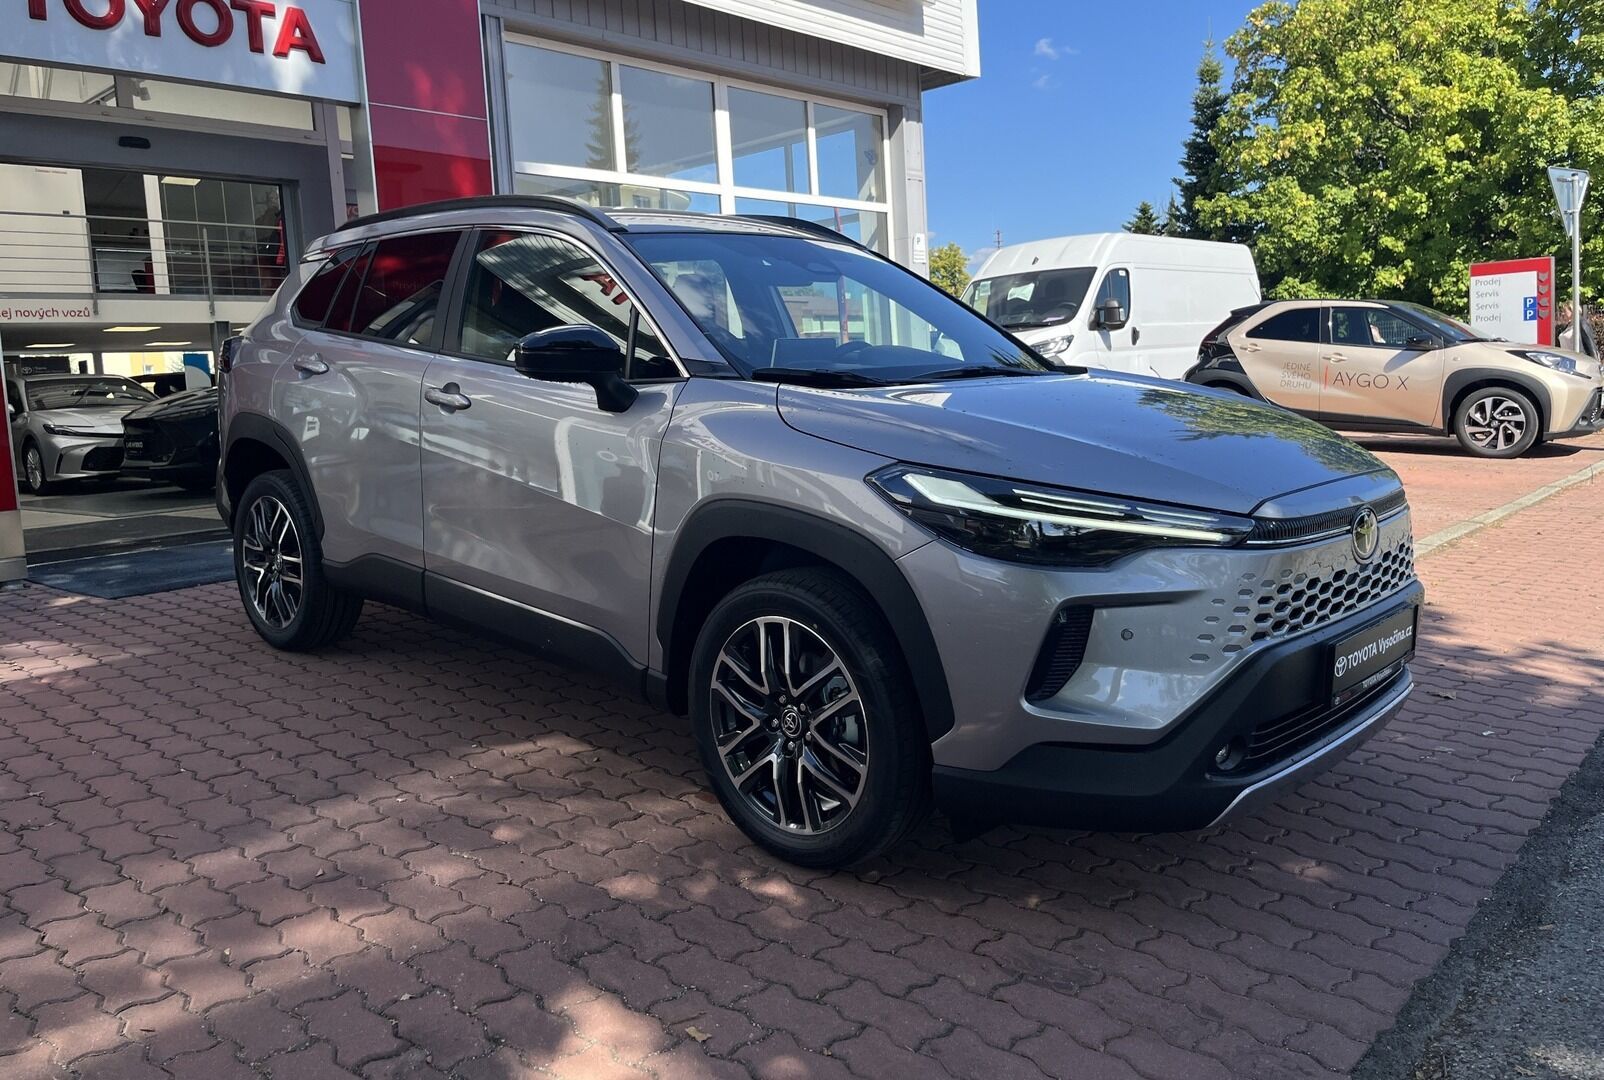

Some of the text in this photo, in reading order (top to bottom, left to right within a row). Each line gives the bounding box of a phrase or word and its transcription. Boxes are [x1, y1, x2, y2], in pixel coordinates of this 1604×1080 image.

[1474, 278, 1501, 287] Prodej
[1475, 290, 1500, 299] Servis
[1475, 303, 1500, 311] Servis
[1526, 297, 1534, 308] P
[15, 307, 60, 320] nových
[62, 306, 91, 318] vozů
[1526, 310, 1534, 320] P
[1475, 314, 1502, 323] Prodej
[1280, 379, 1312, 390] DRUHU
[1333, 371, 1410, 391] AYGO X
[1347, 625, 1413, 669] TOYOTA Vysočina.cz
